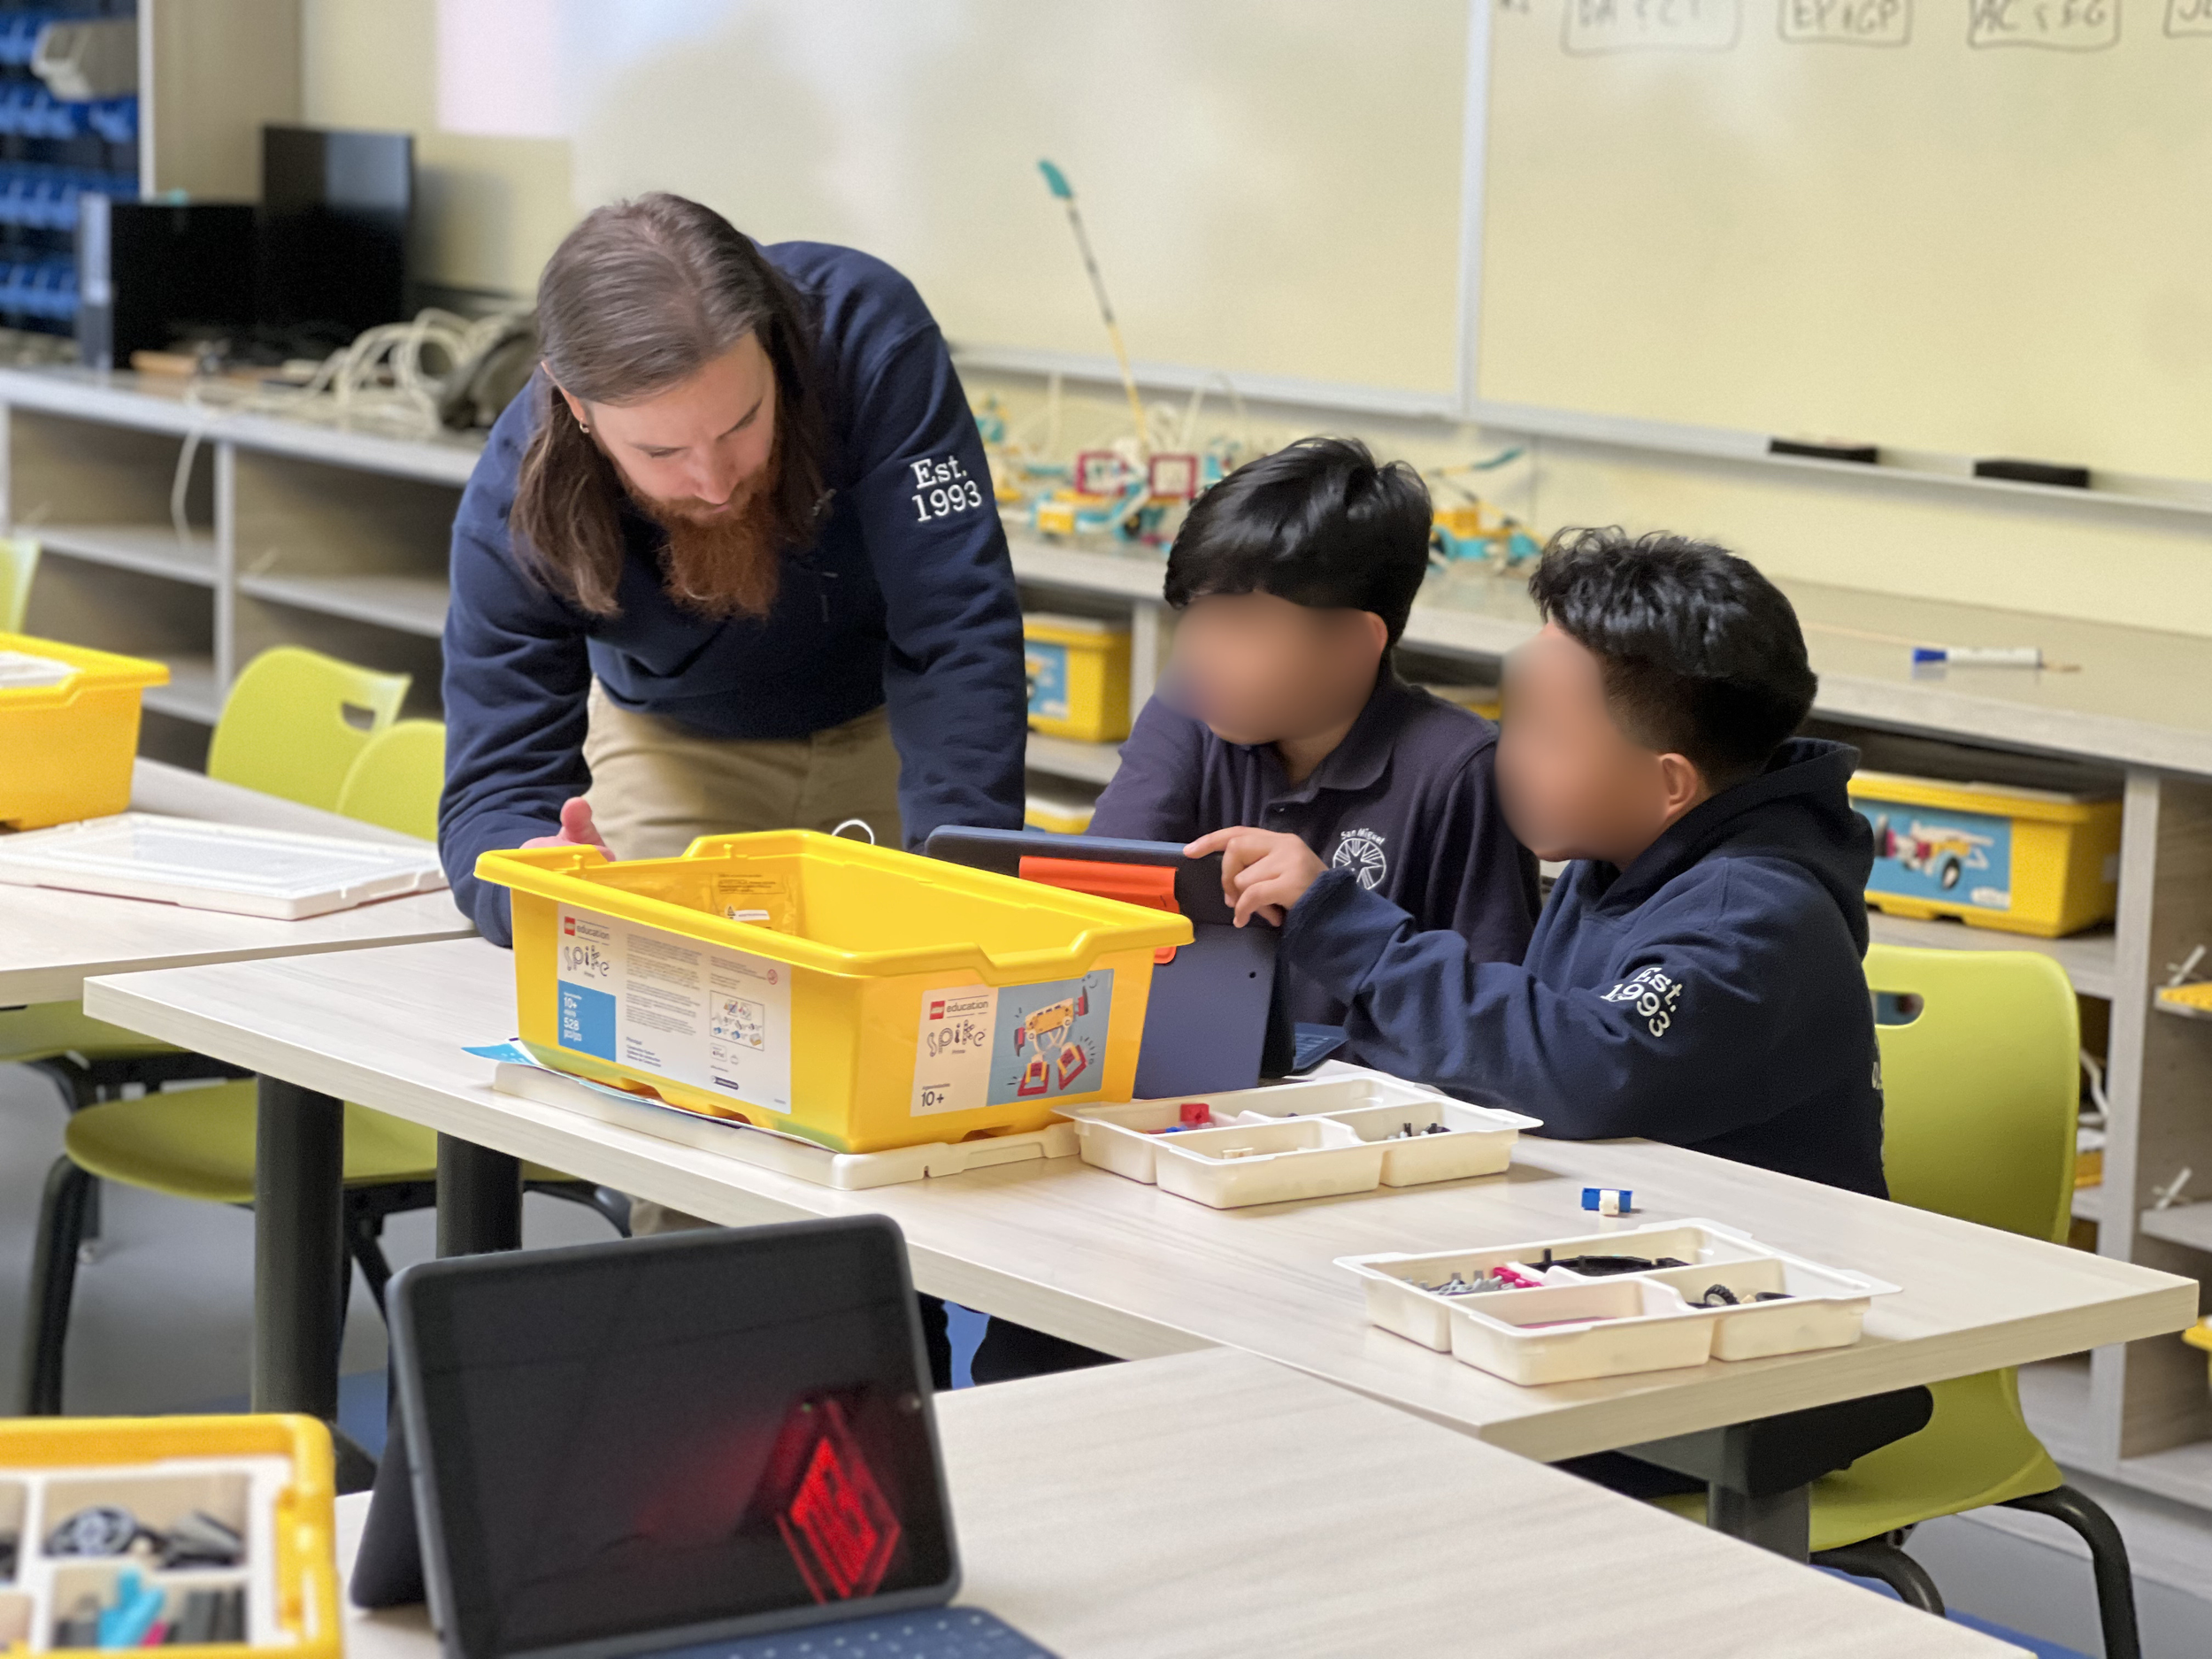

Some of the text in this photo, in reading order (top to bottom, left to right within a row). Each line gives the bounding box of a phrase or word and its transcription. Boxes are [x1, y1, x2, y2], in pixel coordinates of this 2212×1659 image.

[910, 455, 967, 489] Est.
[911, 480, 981, 522] 1993
[1340, 827, 1385, 846] San Miguel
[577, 925, 610, 940] education
[564, 944, 610, 977] spike
[564, 996, 577, 1009] 10+
[1632, 967, 1683, 1012] Est.
[946, 1001, 988, 1013] education
[1600, 983, 1671, 1037] 1993
[564, 1017, 580, 1031] 528
[926, 1019, 986, 1057] spike
[921, 1091, 944, 1107] 10+
